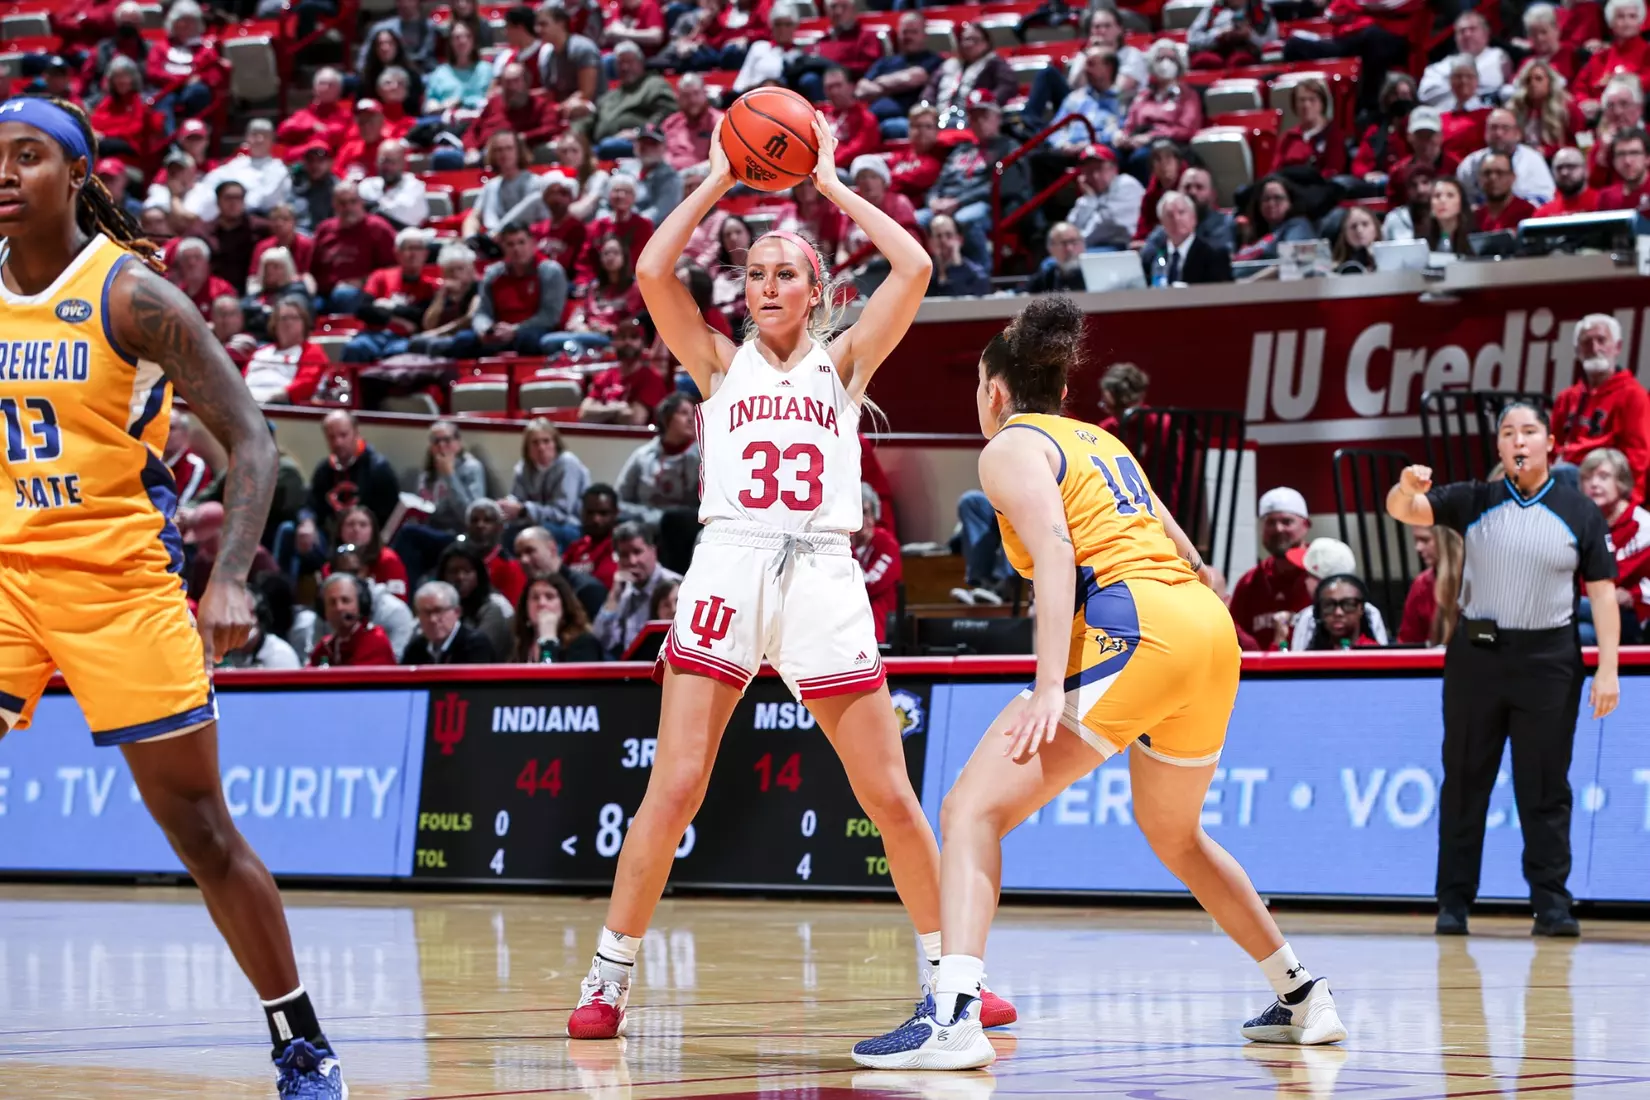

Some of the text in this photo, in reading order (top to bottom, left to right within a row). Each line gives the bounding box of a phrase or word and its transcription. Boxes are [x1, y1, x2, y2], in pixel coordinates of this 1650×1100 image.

[744, 155, 778, 180] adidas
[61, 305, 85, 317] OVC
[1245, 328, 1327, 422] IU
[1345, 307, 1579, 417] Credit
[0, 397, 63, 463] 13
[729, 395, 840, 438] INDIANA
[738, 441, 825, 511] 33
[1088, 454, 1158, 518] 14
[491, 705, 601, 733] INDIANA
[753, 702, 817, 731] MSU
[621, 738, 658, 769] 3R
[516, 758, 563, 797] 44
[753, 752, 803, 792] 14
[57, 767, 116, 817] TV
[222, 766, 398, 819] CURITY
[418, 809, 510, 837] FOULS 0
[800, 809, 881, 838] 0 FOU
[416, 848, 506, 875] TOL 4
[796, 853, 889, 880] 4 TO
